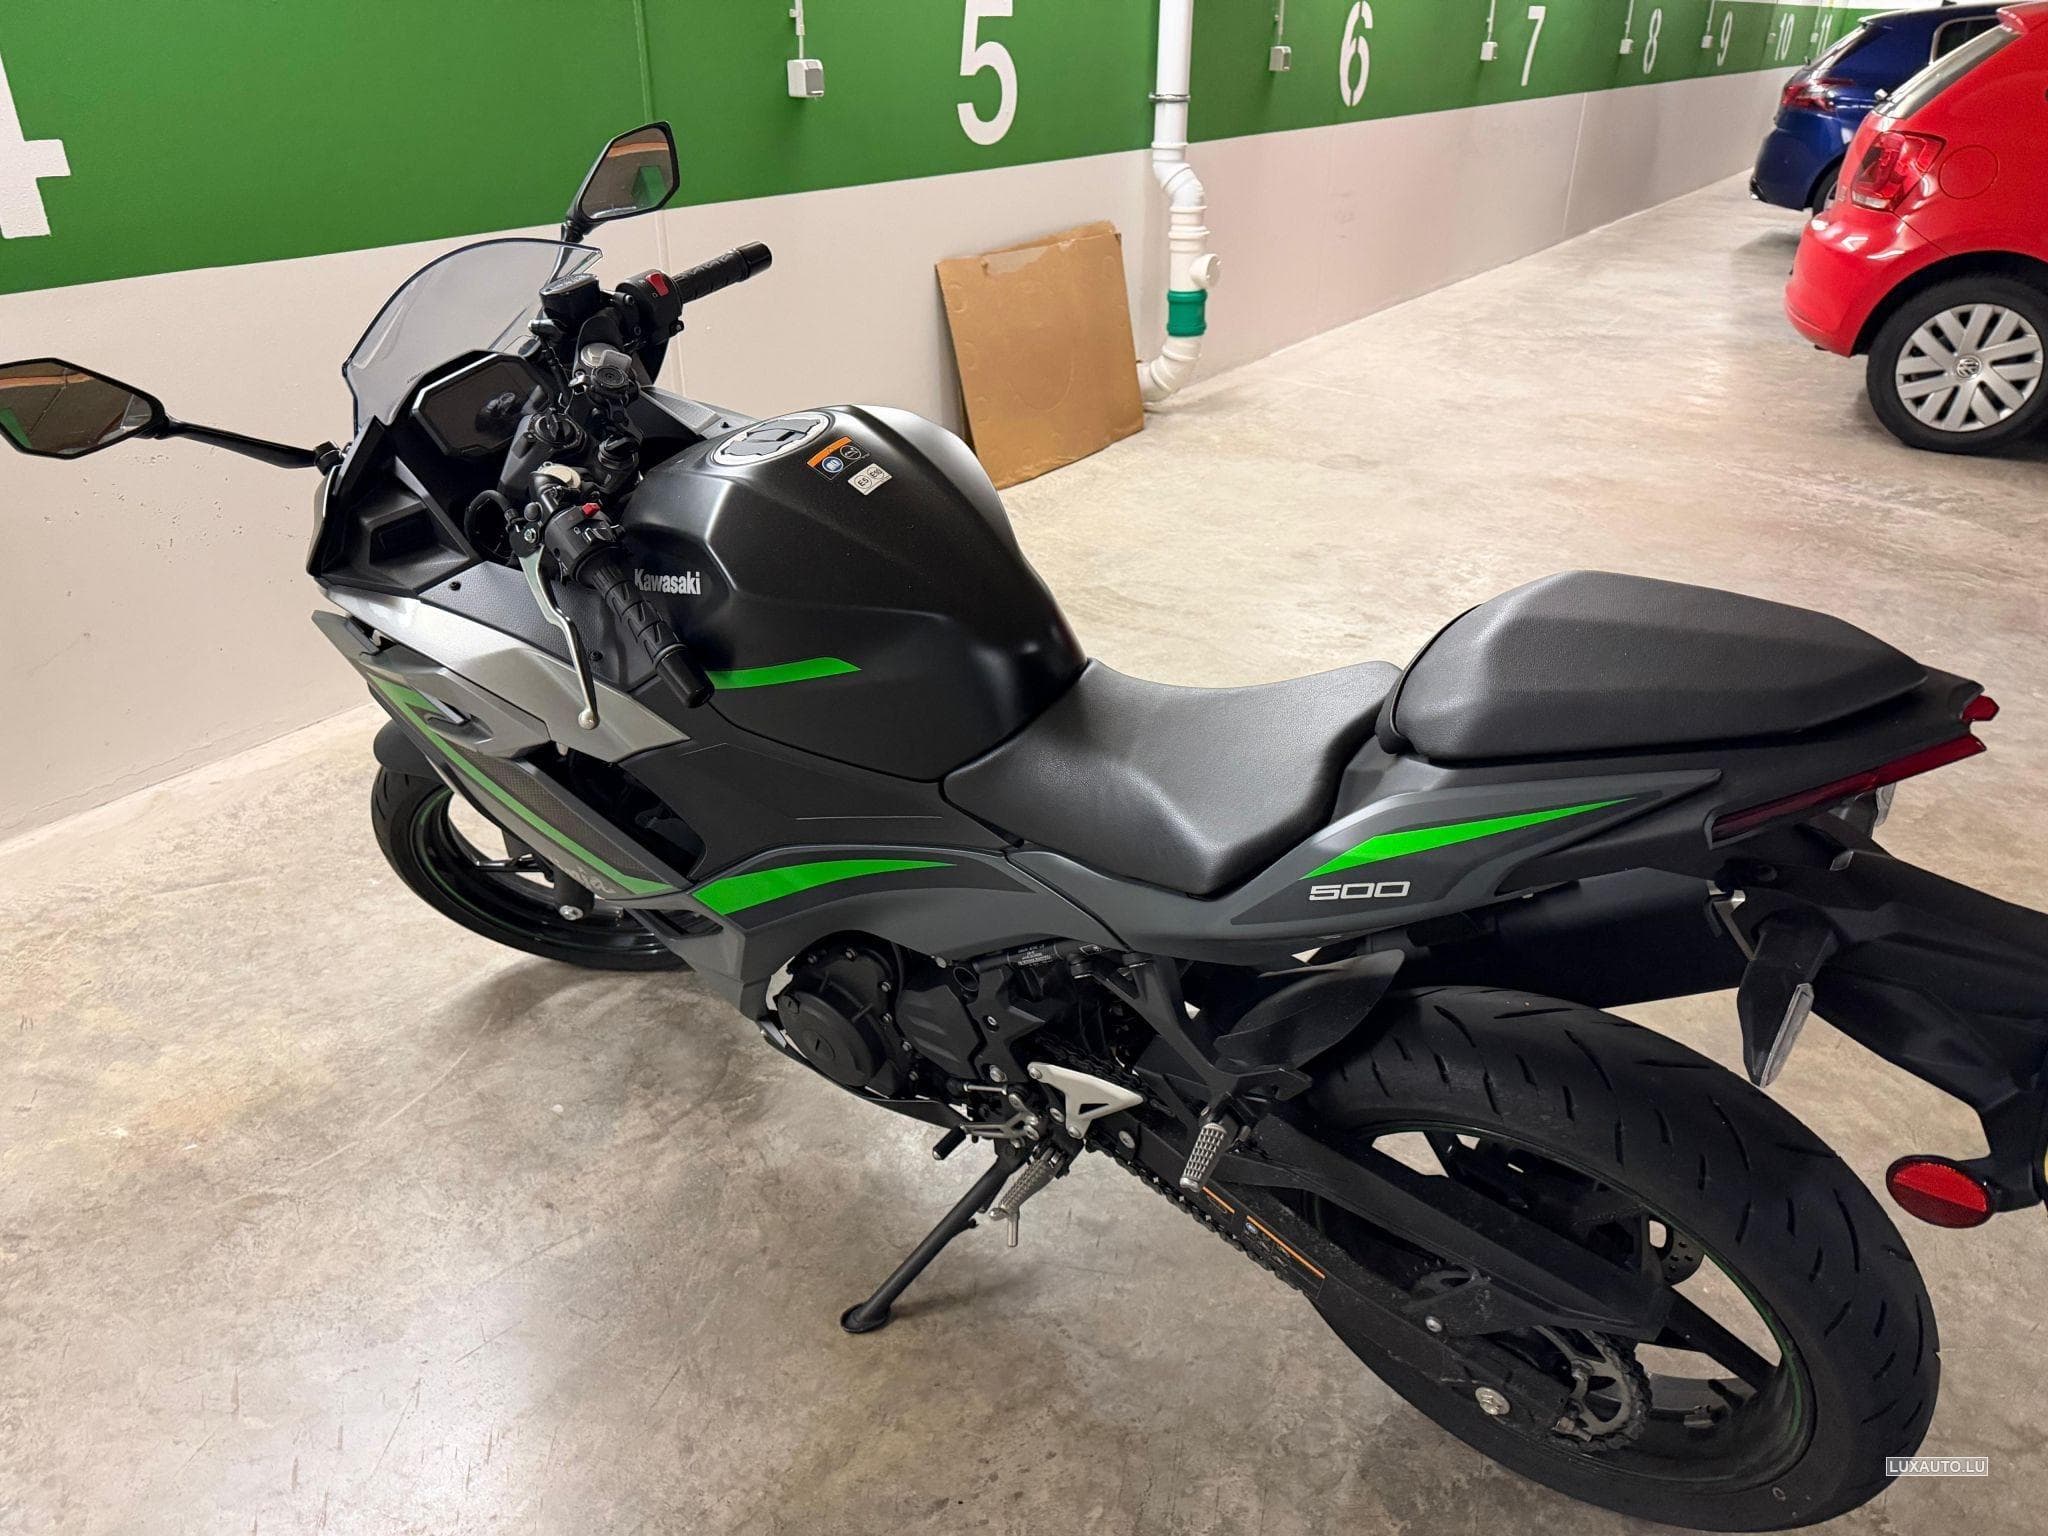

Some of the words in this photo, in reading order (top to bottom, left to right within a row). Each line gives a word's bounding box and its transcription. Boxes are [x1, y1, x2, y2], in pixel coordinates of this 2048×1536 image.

[1339, 1, 1373, 107] 6
[1521, 6, 1546, 87] 7
[1643, 8, 1663, 74] 8
[1717, 11, 1733, 67] 9
[1774, 12, 1795, 61] 10
[1816, 14, 1833, 56] 11
[957, 0, 1018, 145] 5
[634, 568, 701, 595] Kawasaki
[1309, 881, 1411, 901] 500
